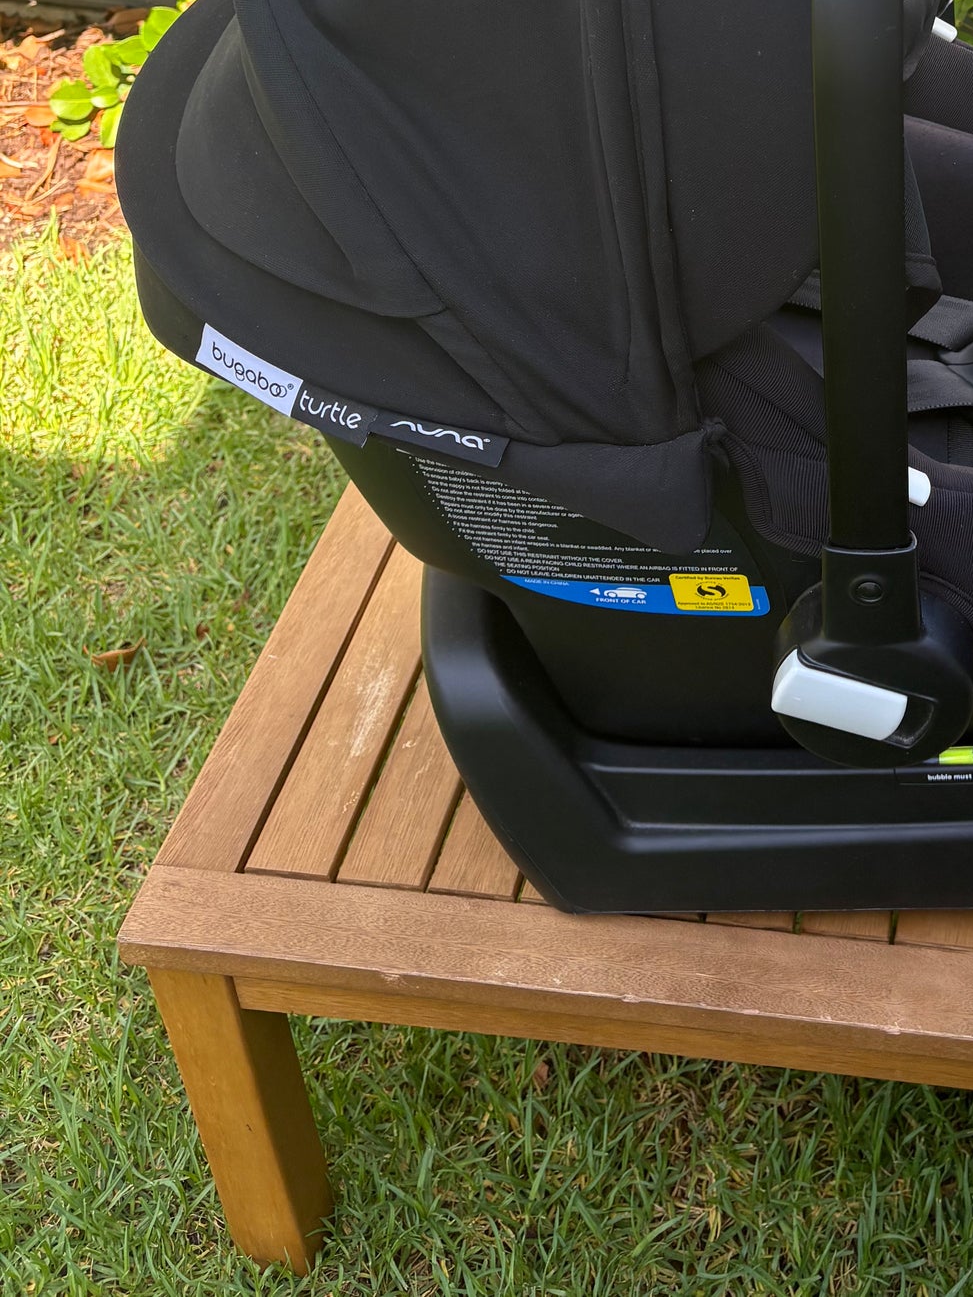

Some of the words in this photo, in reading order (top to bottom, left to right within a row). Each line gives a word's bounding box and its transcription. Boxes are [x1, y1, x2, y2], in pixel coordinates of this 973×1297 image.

[299, 390, 362, 430] turtle
[527, 552, 560, 560] RESTRAINT
[583, 562, 616, 570] RESTRAINT
[583, 574, 624, 582] UNATTENDED
[927, 773, 952, 781] bubble
